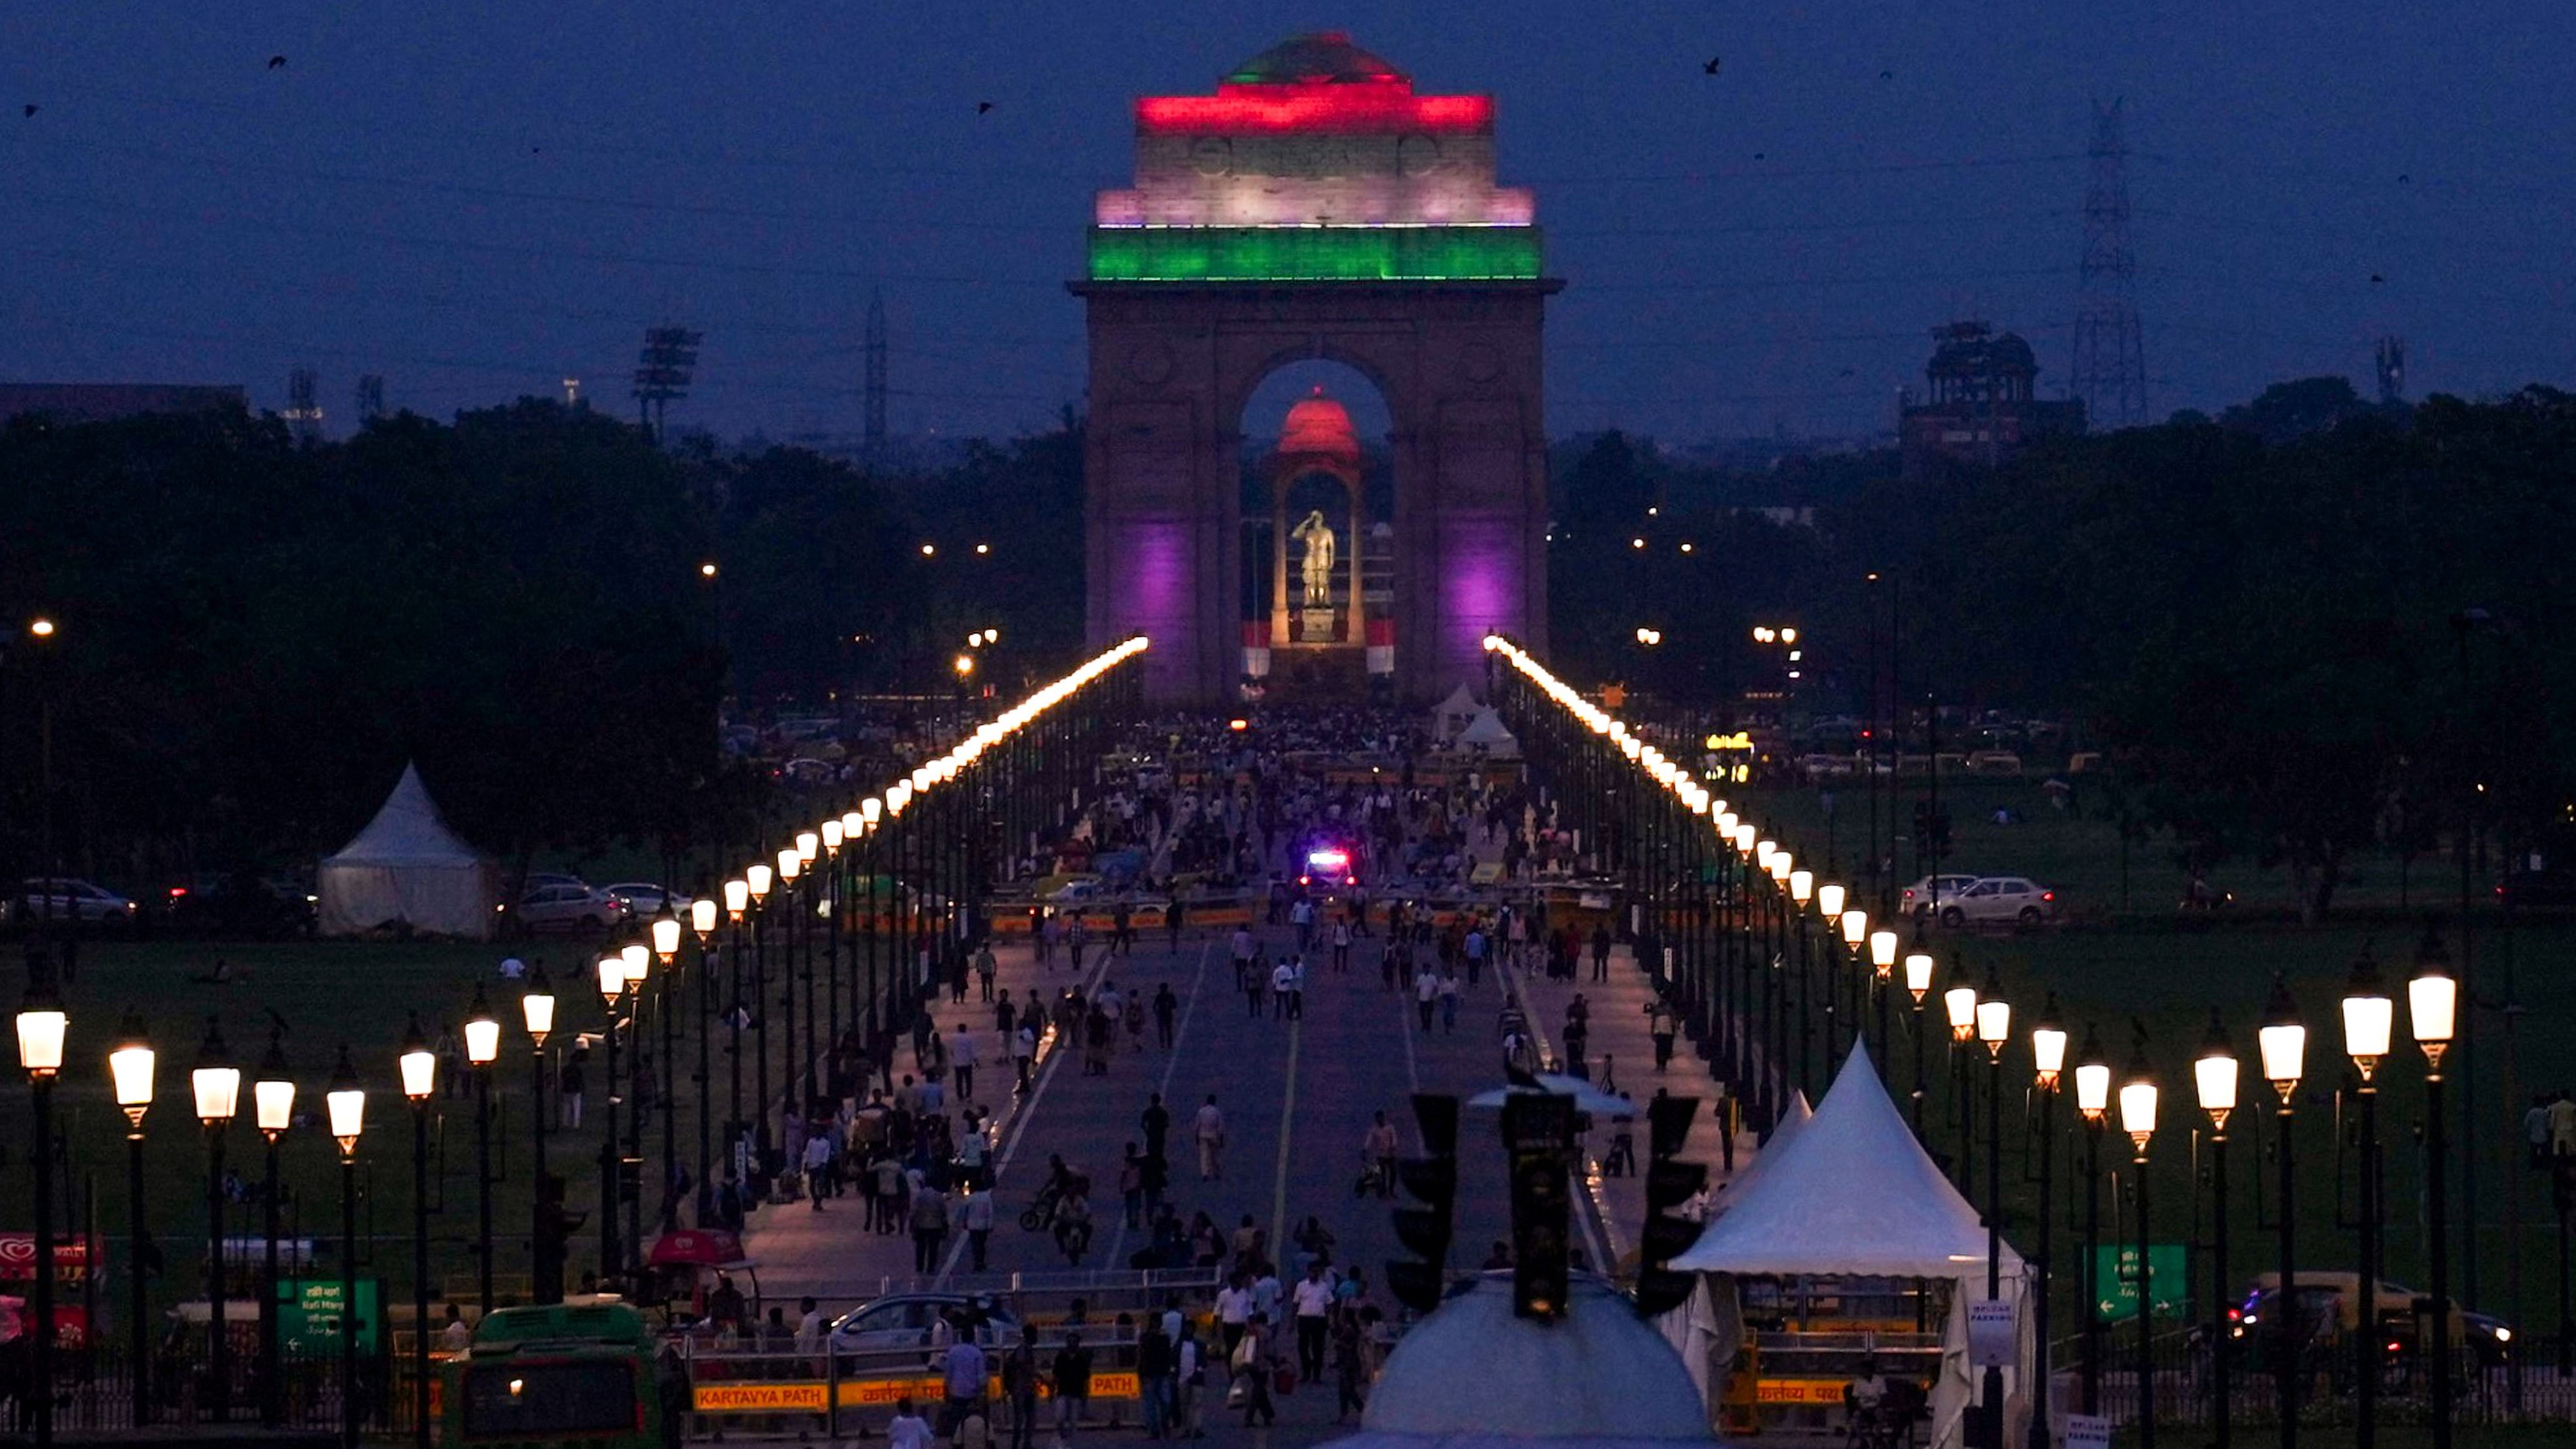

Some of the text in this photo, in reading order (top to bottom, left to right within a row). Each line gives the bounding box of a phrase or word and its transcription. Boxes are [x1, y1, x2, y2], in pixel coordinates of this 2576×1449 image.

[1095, 1377, 1132, 1392] PATH
[699, 1389, 821, 1405] KARTAVYA PATH
